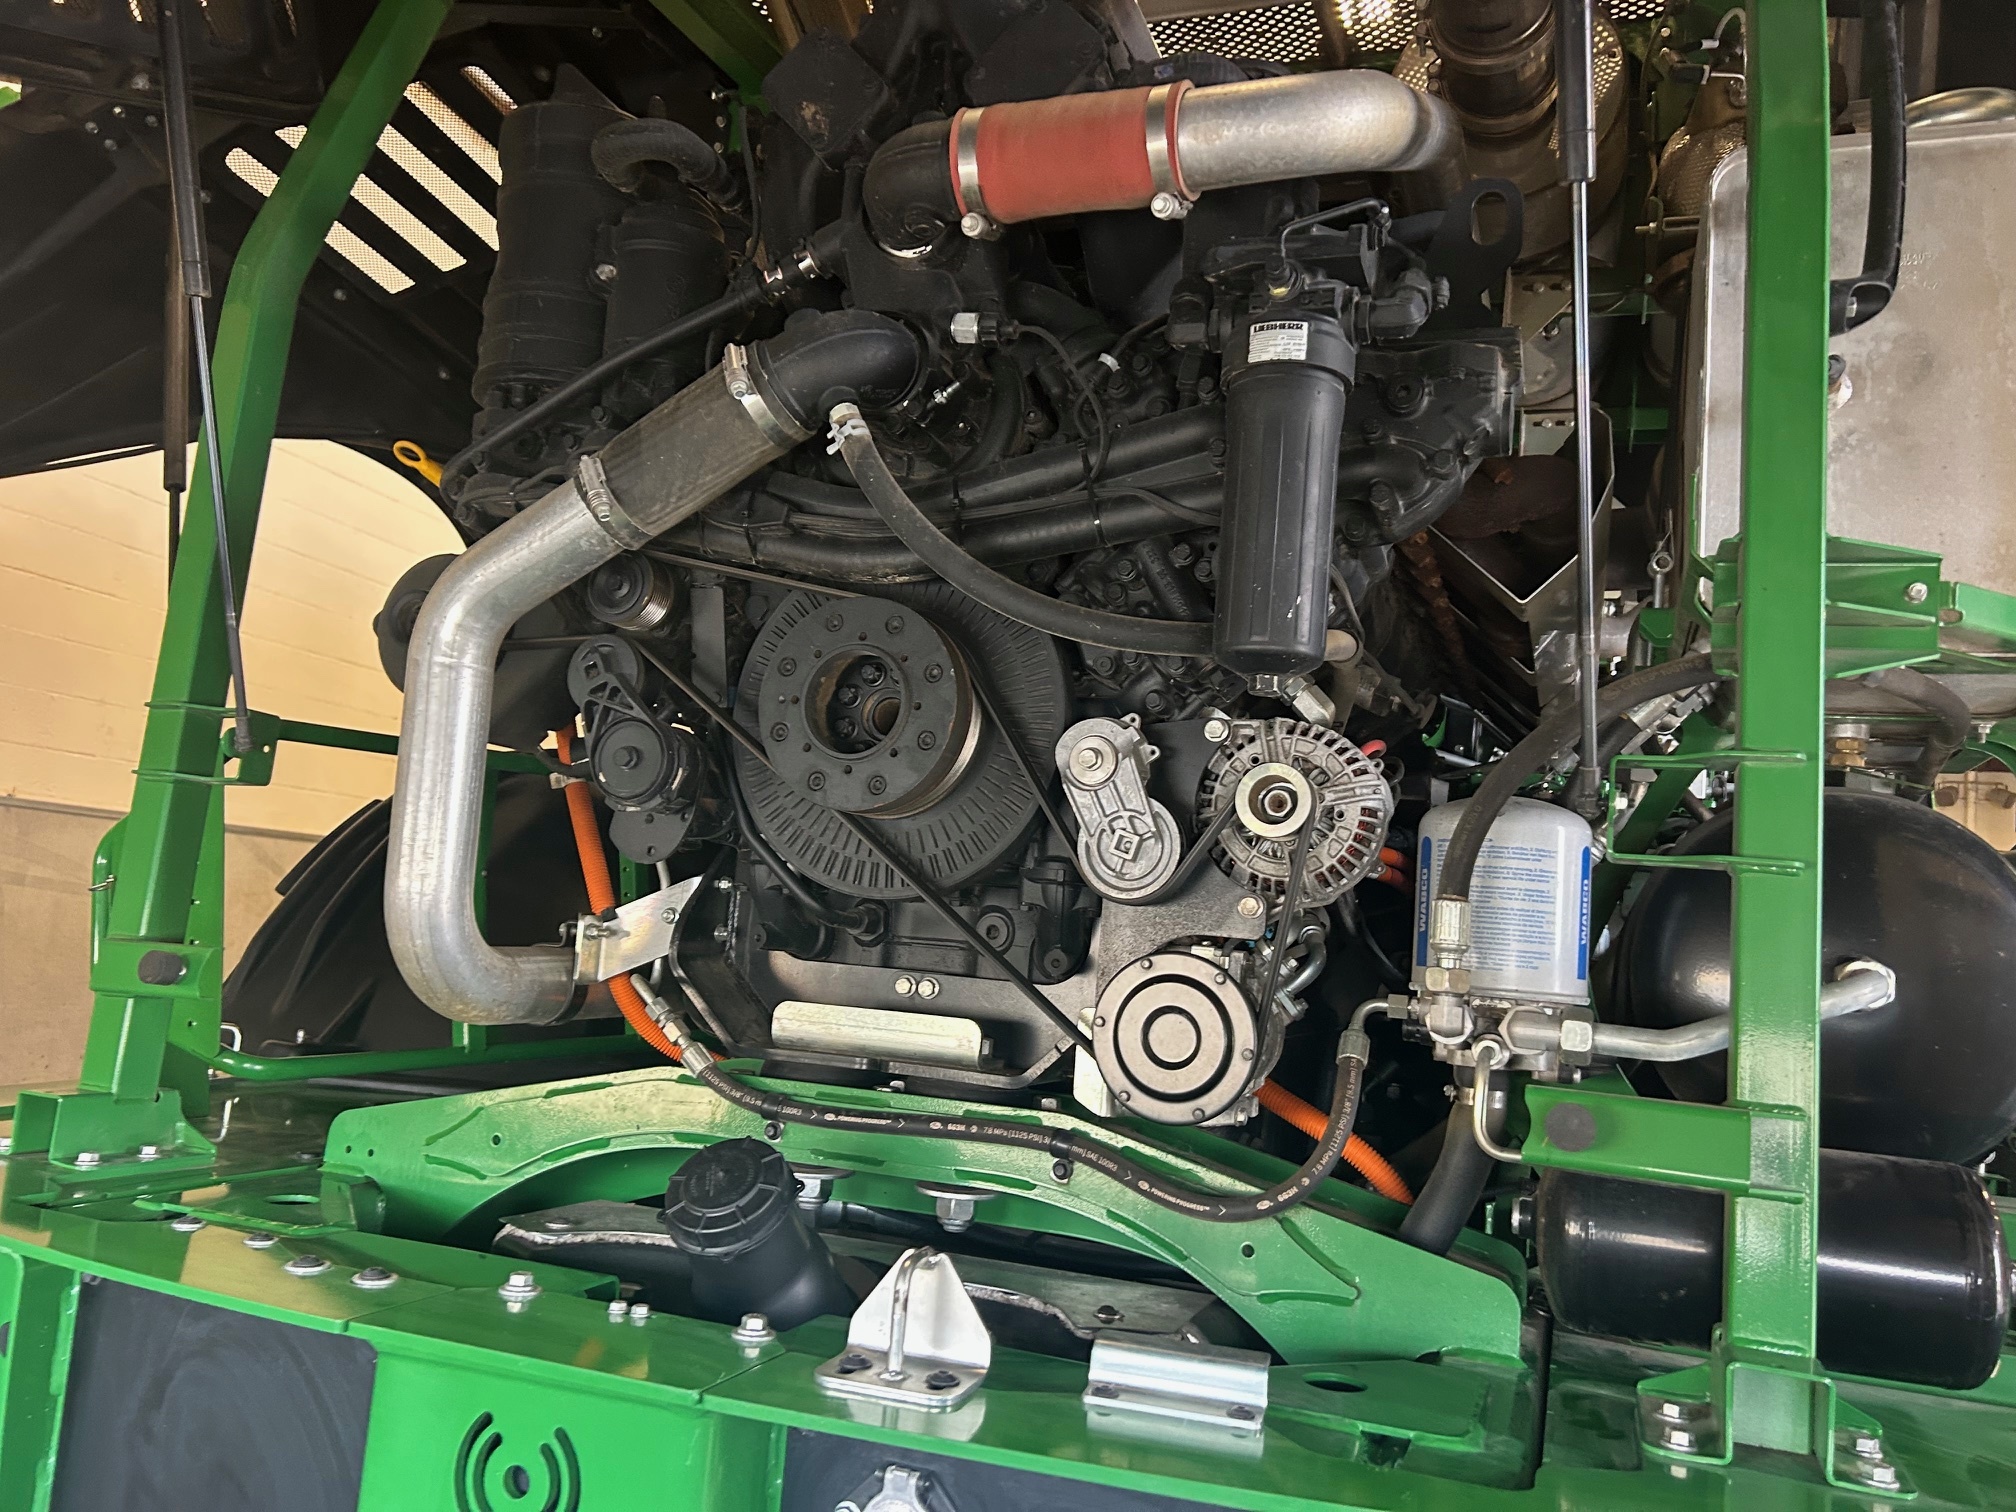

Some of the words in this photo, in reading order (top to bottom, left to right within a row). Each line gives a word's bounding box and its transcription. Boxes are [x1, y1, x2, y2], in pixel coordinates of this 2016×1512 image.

[1253, 322, 1304, 333] LIEBHERR
[1419, 868, 1428, 932] WABCO
[1581, 879, 1589, 945] WABCO
[993, 1127, 1008, 1136] MPa
[1086, 1150, 1100, 1162] SAE
[1097, 1156, 1119, 1172] 100R3
[1320, 1151, 1334, 1167] MPa
